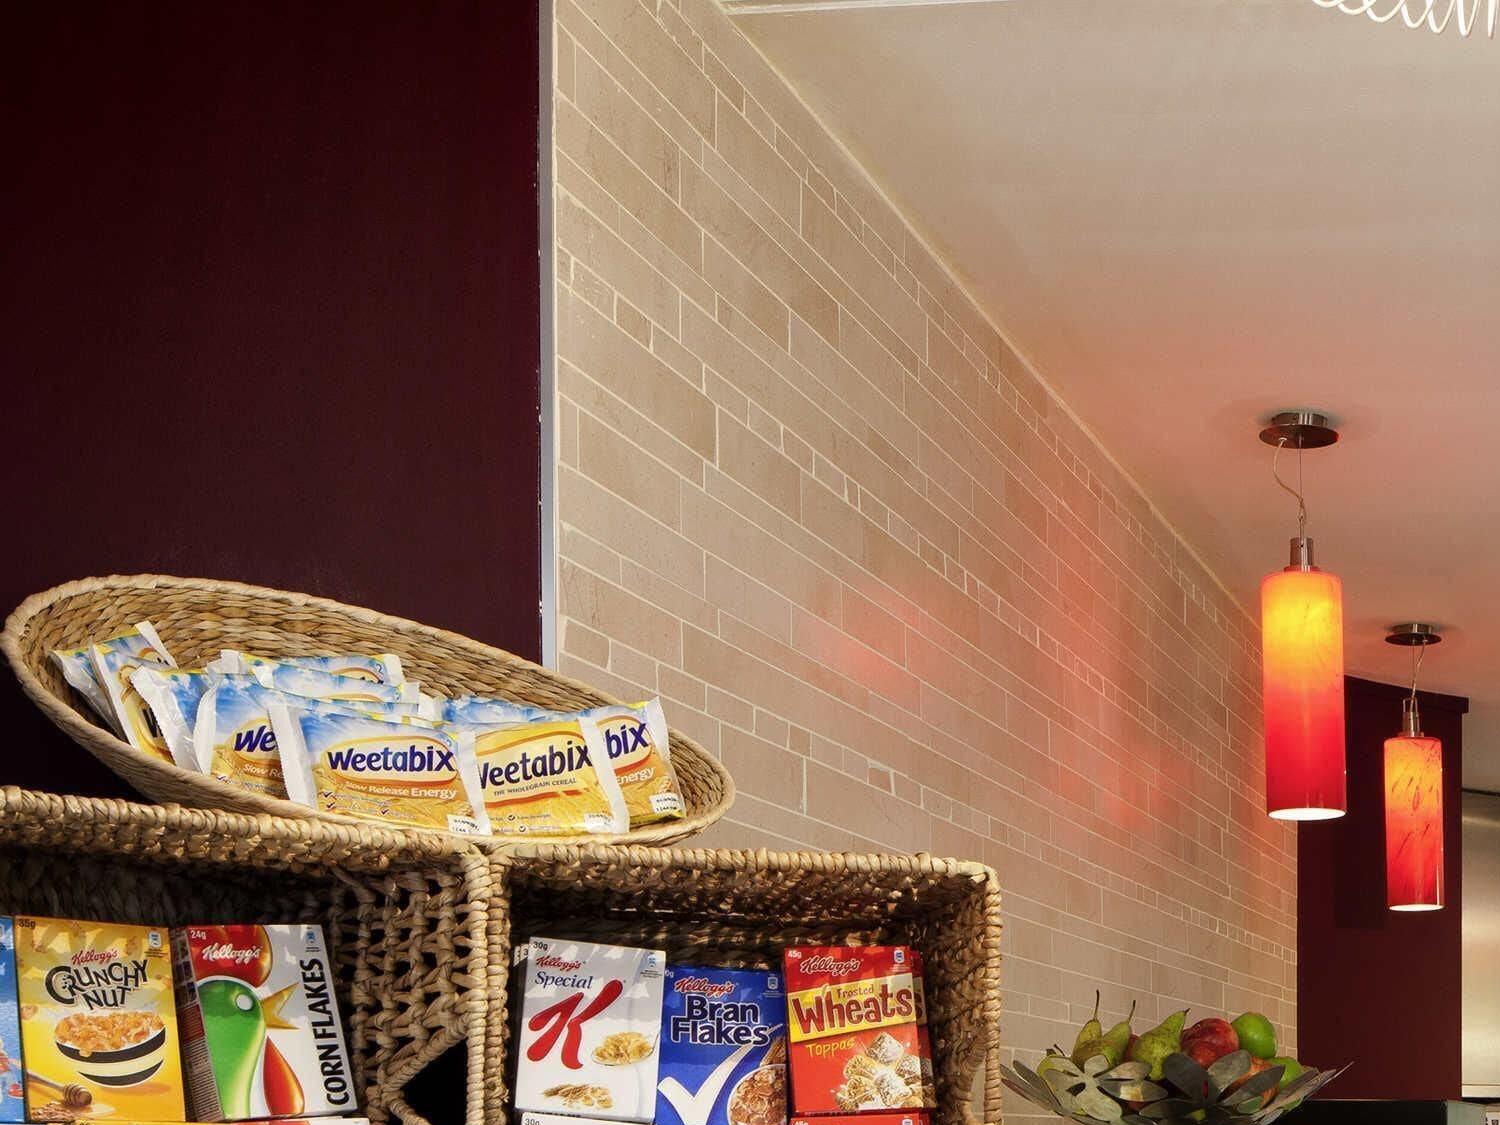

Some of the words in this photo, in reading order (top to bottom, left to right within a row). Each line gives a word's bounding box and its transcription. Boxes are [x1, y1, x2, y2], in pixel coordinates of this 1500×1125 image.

[328, 744, 456, 772] Weetabix
[368, 785, 410, 797] Release
[411, 787, 457, 800] Energy
[493, 788, 506, 797] THE
[506, 780, 551, 794] WHOLEGRAIN
[551, 777, 577, 787] CEREAL
[18, 918, 36, 929] 35g
[190, 930, 206, 940] 24g
[202, 943, 261, 963] Kellogg's
[532, 941, 548, 951] 30g
[788, 950, 802, 959] 45g
[71, 949, 118, 965] Kellogg's
[536, 955, 581, 971] Kellogg's
[800, 955, 860, 976] Kellogg's
[45, 959, 148, 1005] CRUNCHY
[534, 971, 593, 989] Special
[664, 969, 674, 978] 0g
[674, 976, 735, 997] Kellogg's
[836, 984, 874, 999] Frosted
[82, 986, 131, 1010] NUT
[300, 958, 337, 1040] FLAKES
[686, 993, 760, 1023] Bran
[792, 984, 913, 1034] Wheats
[527, 979, 624, 1069] K
[671, 1016, 771, 1046] Flakes
[316, 1043, 350, 1105] CORN
